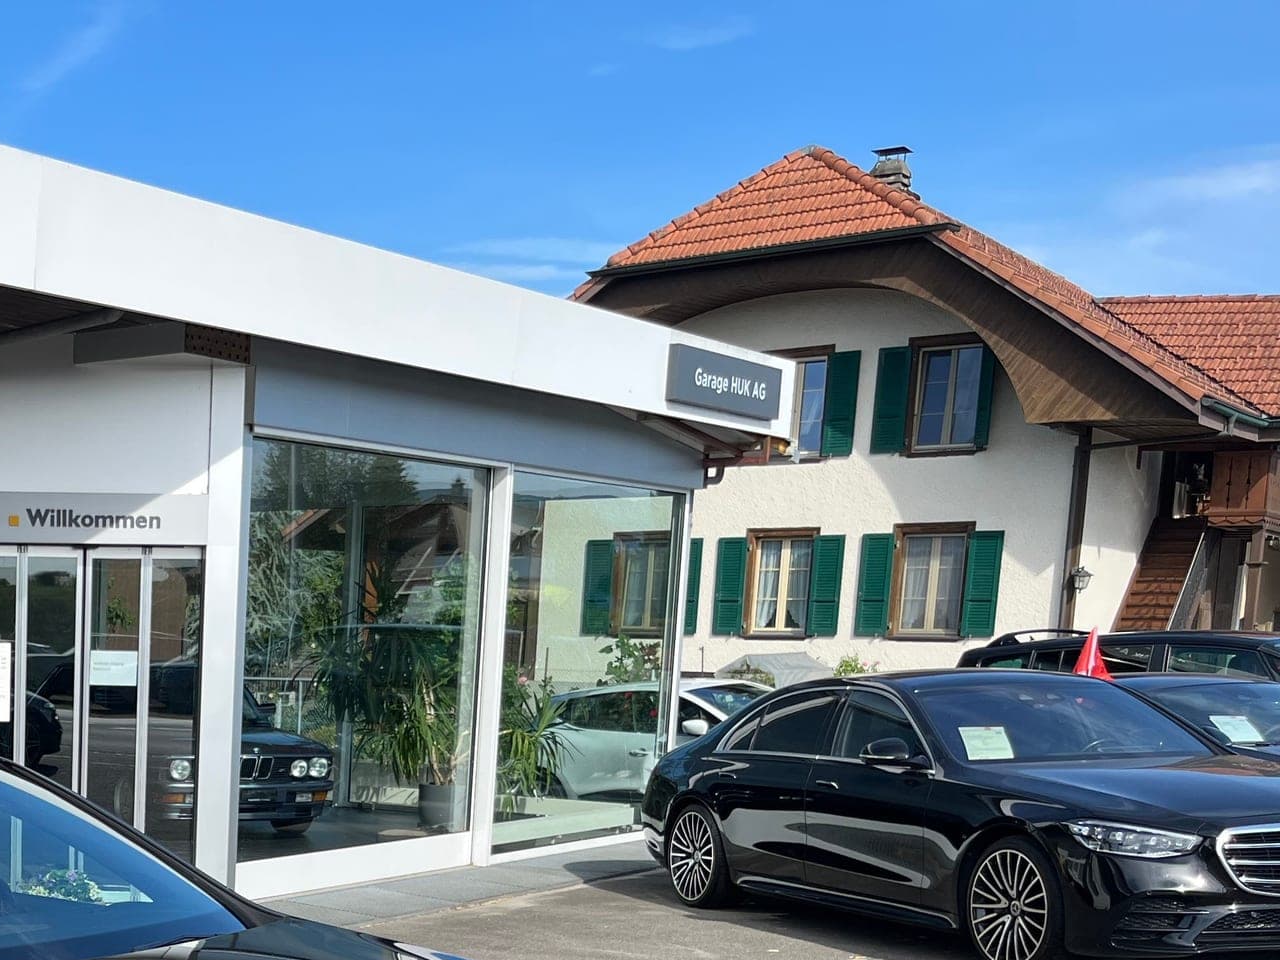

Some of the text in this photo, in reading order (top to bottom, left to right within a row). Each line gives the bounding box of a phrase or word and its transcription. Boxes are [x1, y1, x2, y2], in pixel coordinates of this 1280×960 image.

[695, 367, 766, 400] Garage HUK AG
[26, 508, 161, 529] Willkommen
